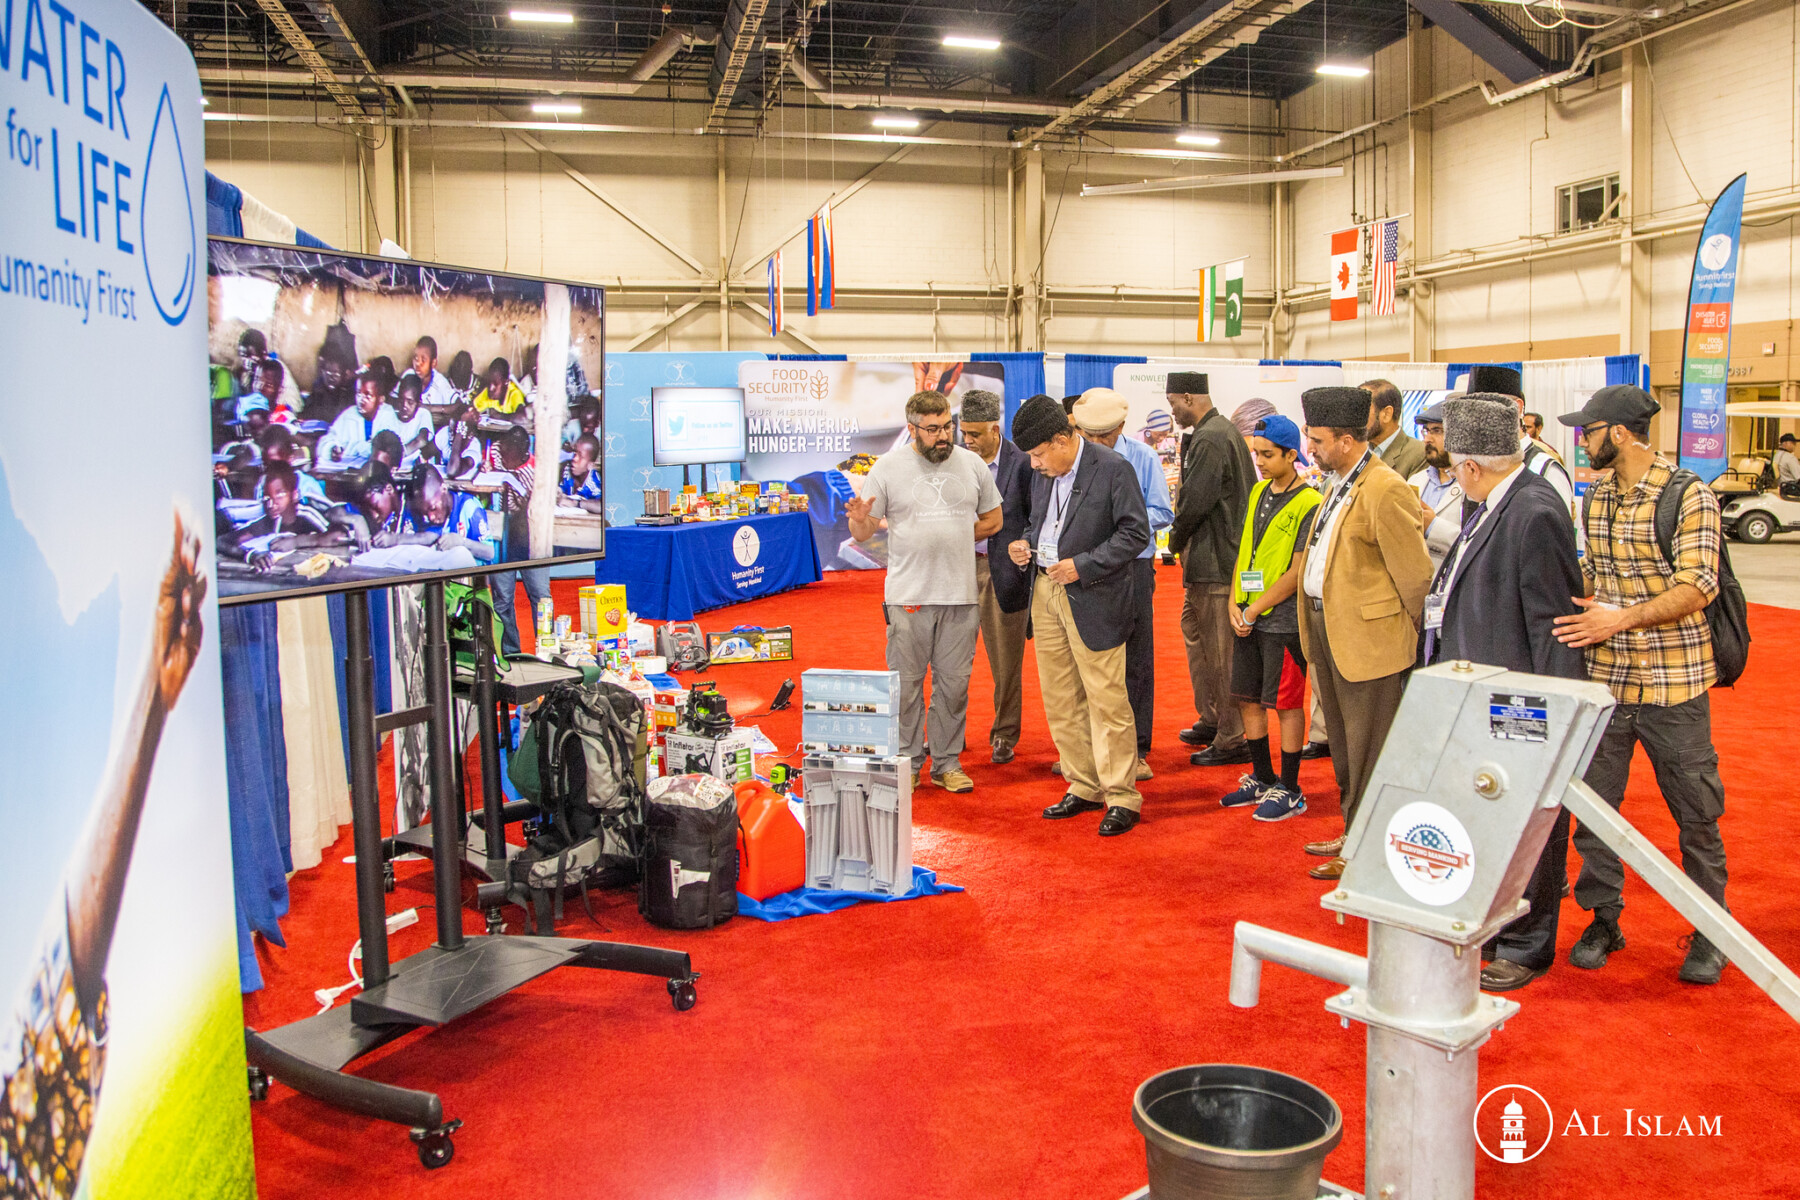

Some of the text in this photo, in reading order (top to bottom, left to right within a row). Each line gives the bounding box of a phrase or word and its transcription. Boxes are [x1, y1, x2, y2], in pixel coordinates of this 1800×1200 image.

[6, 107, 134, 255] for LIFE
[97, 269, 137, 321] First
[772, 369, 808, 380] FOOD
[1130, 374, 1167, 382] KNOWLED
[1728, 366, 1753, 376] OBBY
[748, 382, 807, 394] SECURITY
[748, 417, 860, 434] MAKE AMERICA
[748, 435, 852, 453] HUNGER-FREE
[1401, 844, 1459, 865] SERVING MANKIND
